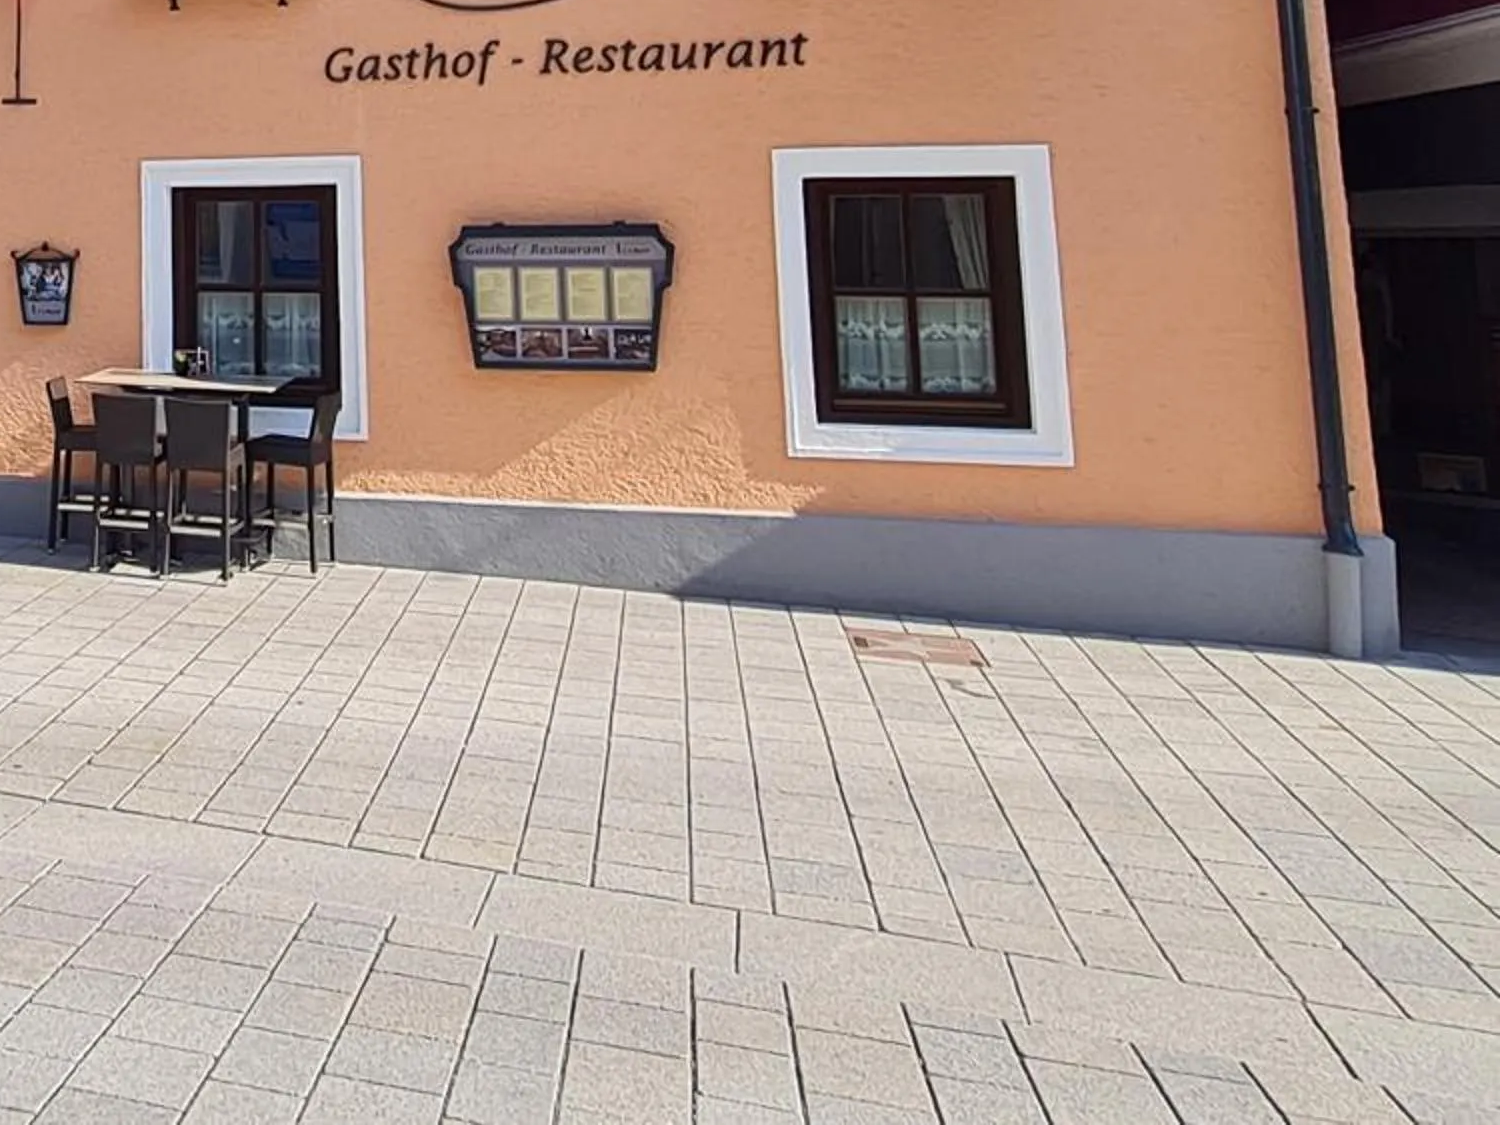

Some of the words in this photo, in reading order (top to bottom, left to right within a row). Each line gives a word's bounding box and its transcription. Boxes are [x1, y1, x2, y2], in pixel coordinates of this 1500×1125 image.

[324, 39, 500, 85] Gasthof
[539, 32, 809, 76] Restaurant
[465, 242, 518, 257] Gasthof
[530, 243, 607, 256] Restaurant
